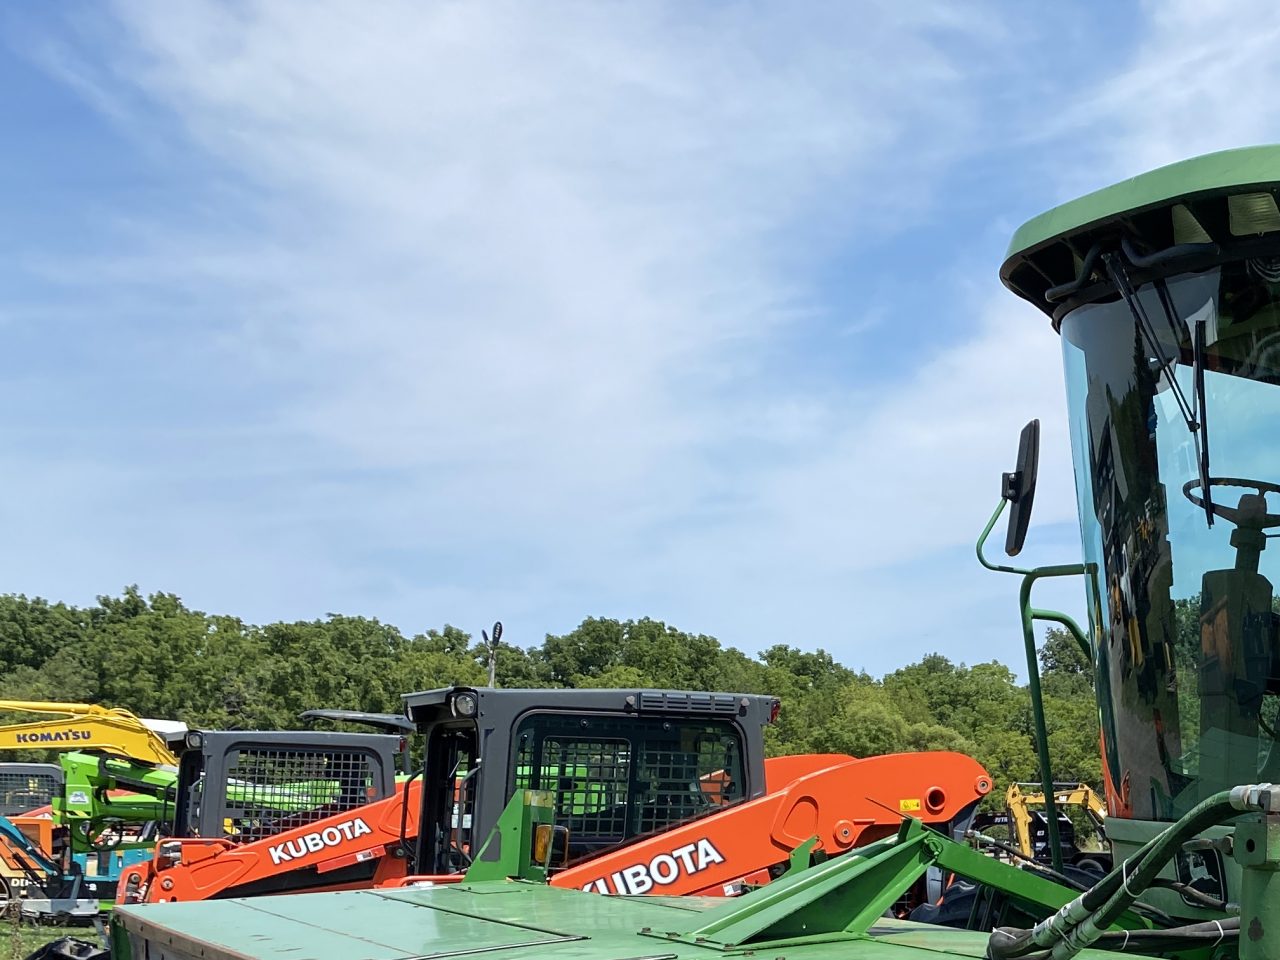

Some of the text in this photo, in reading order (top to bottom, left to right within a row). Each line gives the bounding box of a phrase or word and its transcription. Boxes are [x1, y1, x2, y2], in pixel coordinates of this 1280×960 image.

[16, 729, 91, 743] KOMATSU
[268, 817, 372, 865] KUBOTA
[582, 837, 726, 896] UBOTA
